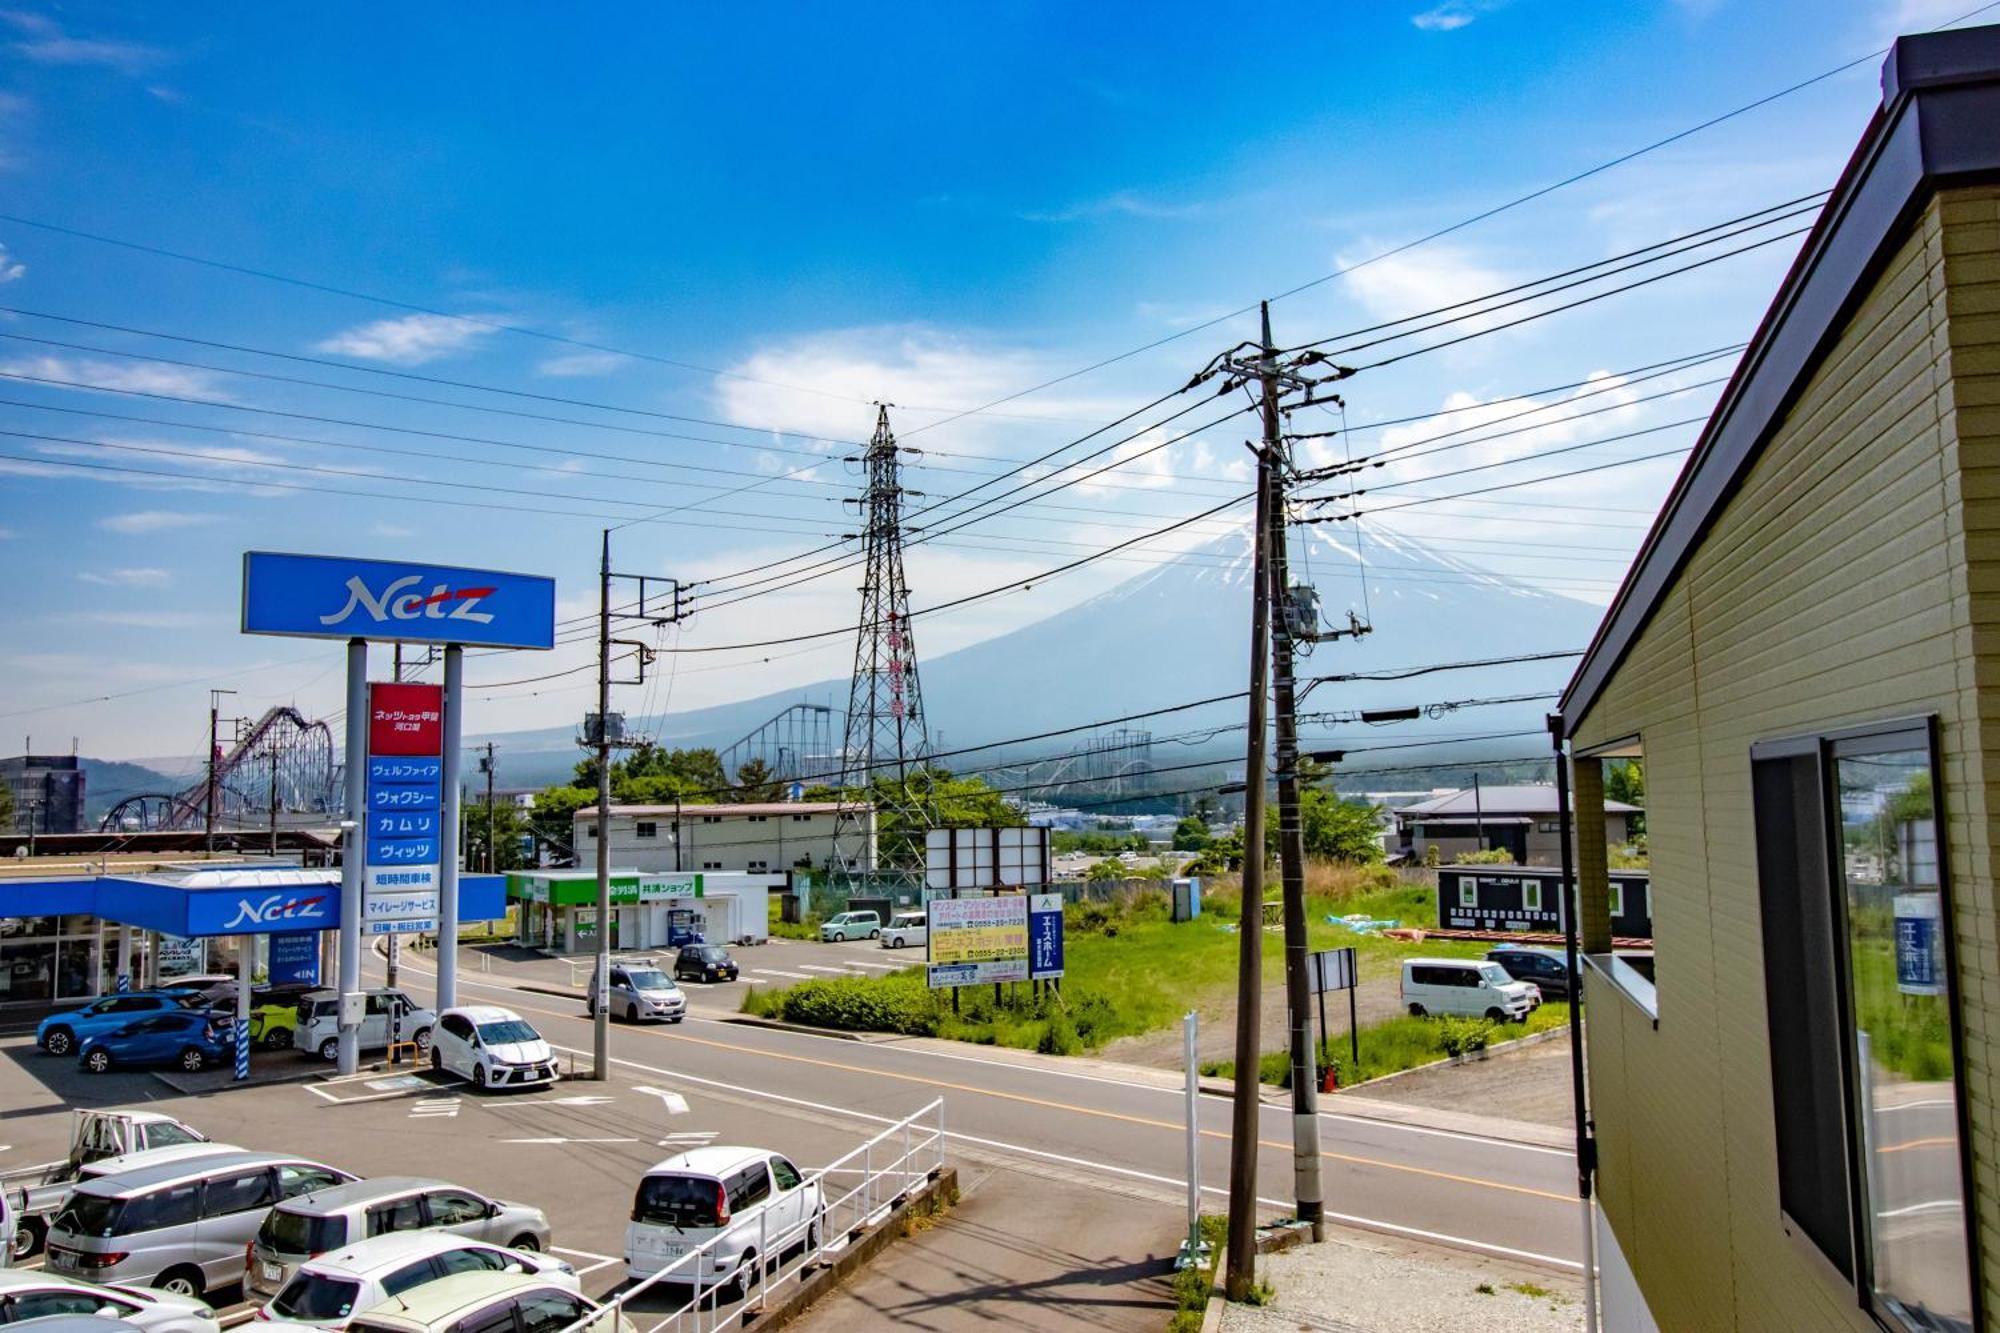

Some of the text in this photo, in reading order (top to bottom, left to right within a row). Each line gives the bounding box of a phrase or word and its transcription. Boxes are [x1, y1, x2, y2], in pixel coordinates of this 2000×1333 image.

[320, 575, 498, 625] Netz
[373, 765, 439, 776] ヴェルファイア
[376, 791, 435, 804] ヴォクシー
[380, 817, 430, 831] カムリ
[381, 845, 430, 858] ヴィッツ
[643, 882, 693, 894] 共済ショップ
[223, 895, 326, 929] Netz
[369, 900, 436, 912] マイレージサービス
[1042, 916, 1053, 967] エースホーム
[302, 969, 315, 979] IN
